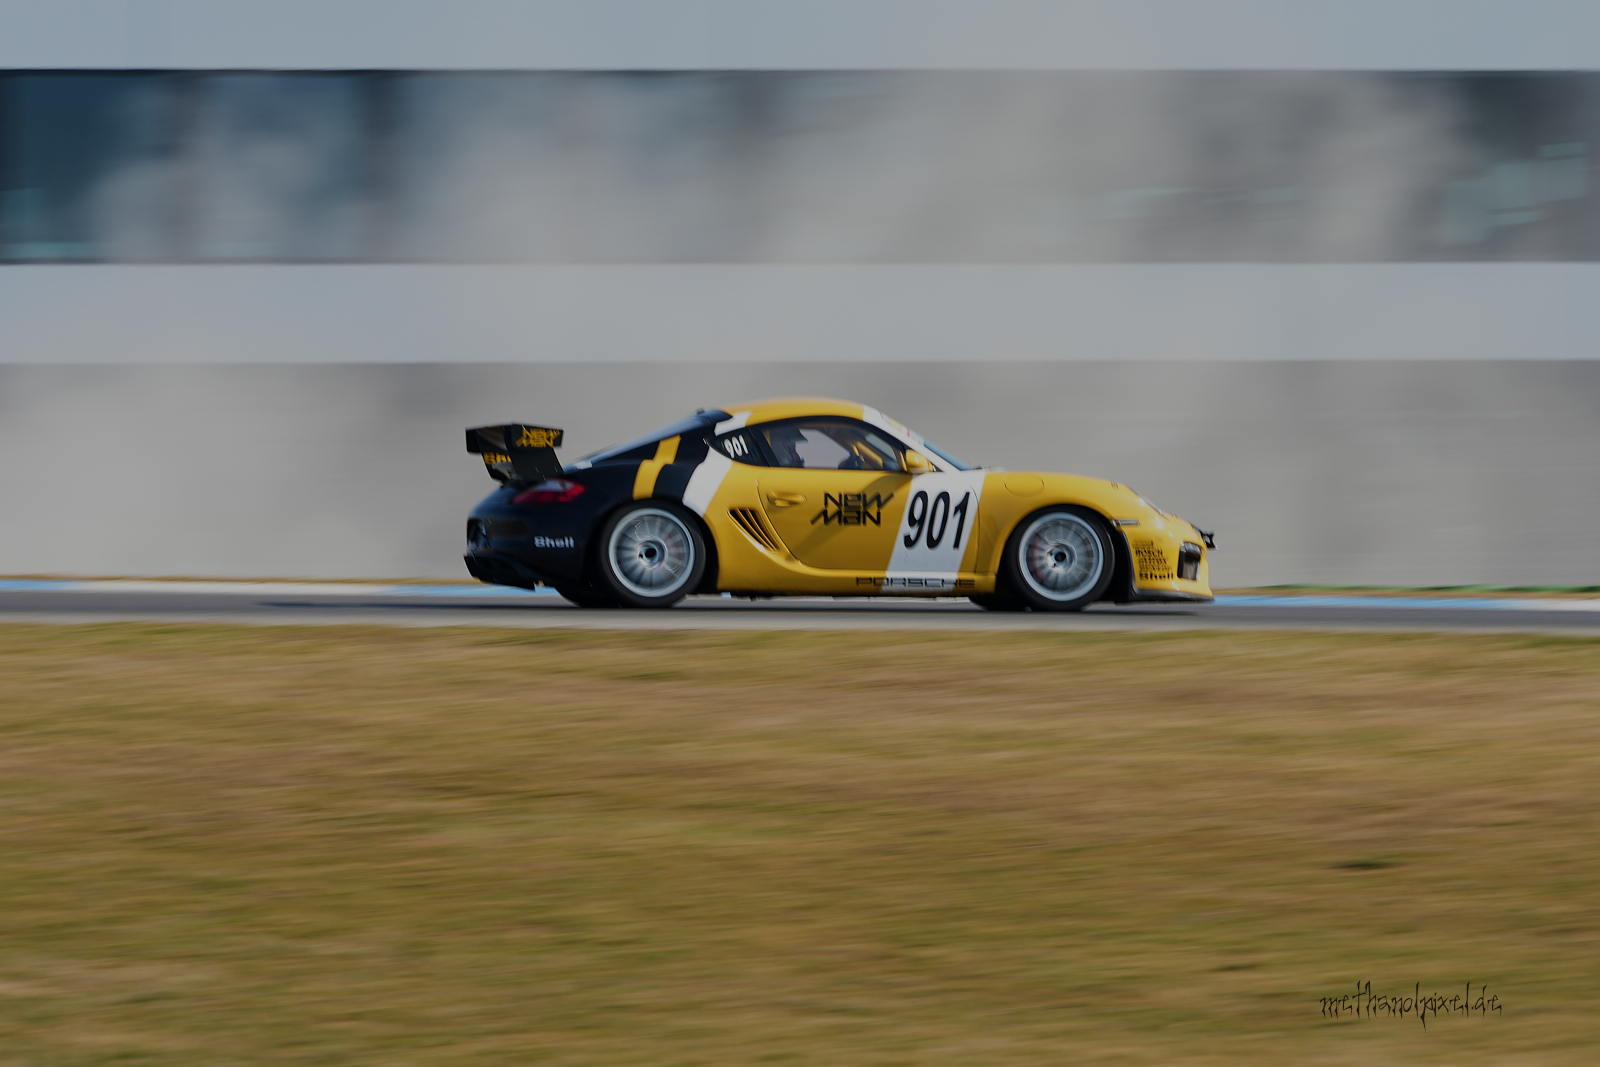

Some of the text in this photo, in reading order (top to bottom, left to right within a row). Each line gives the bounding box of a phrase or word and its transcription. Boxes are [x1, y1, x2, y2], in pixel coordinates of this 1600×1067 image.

[723, 434, 749, 459] 901
[903, 490, 970, 549] 901
[533, 536, 575, 548] Shell
[855, 577, 976, 588] PORSCHE
